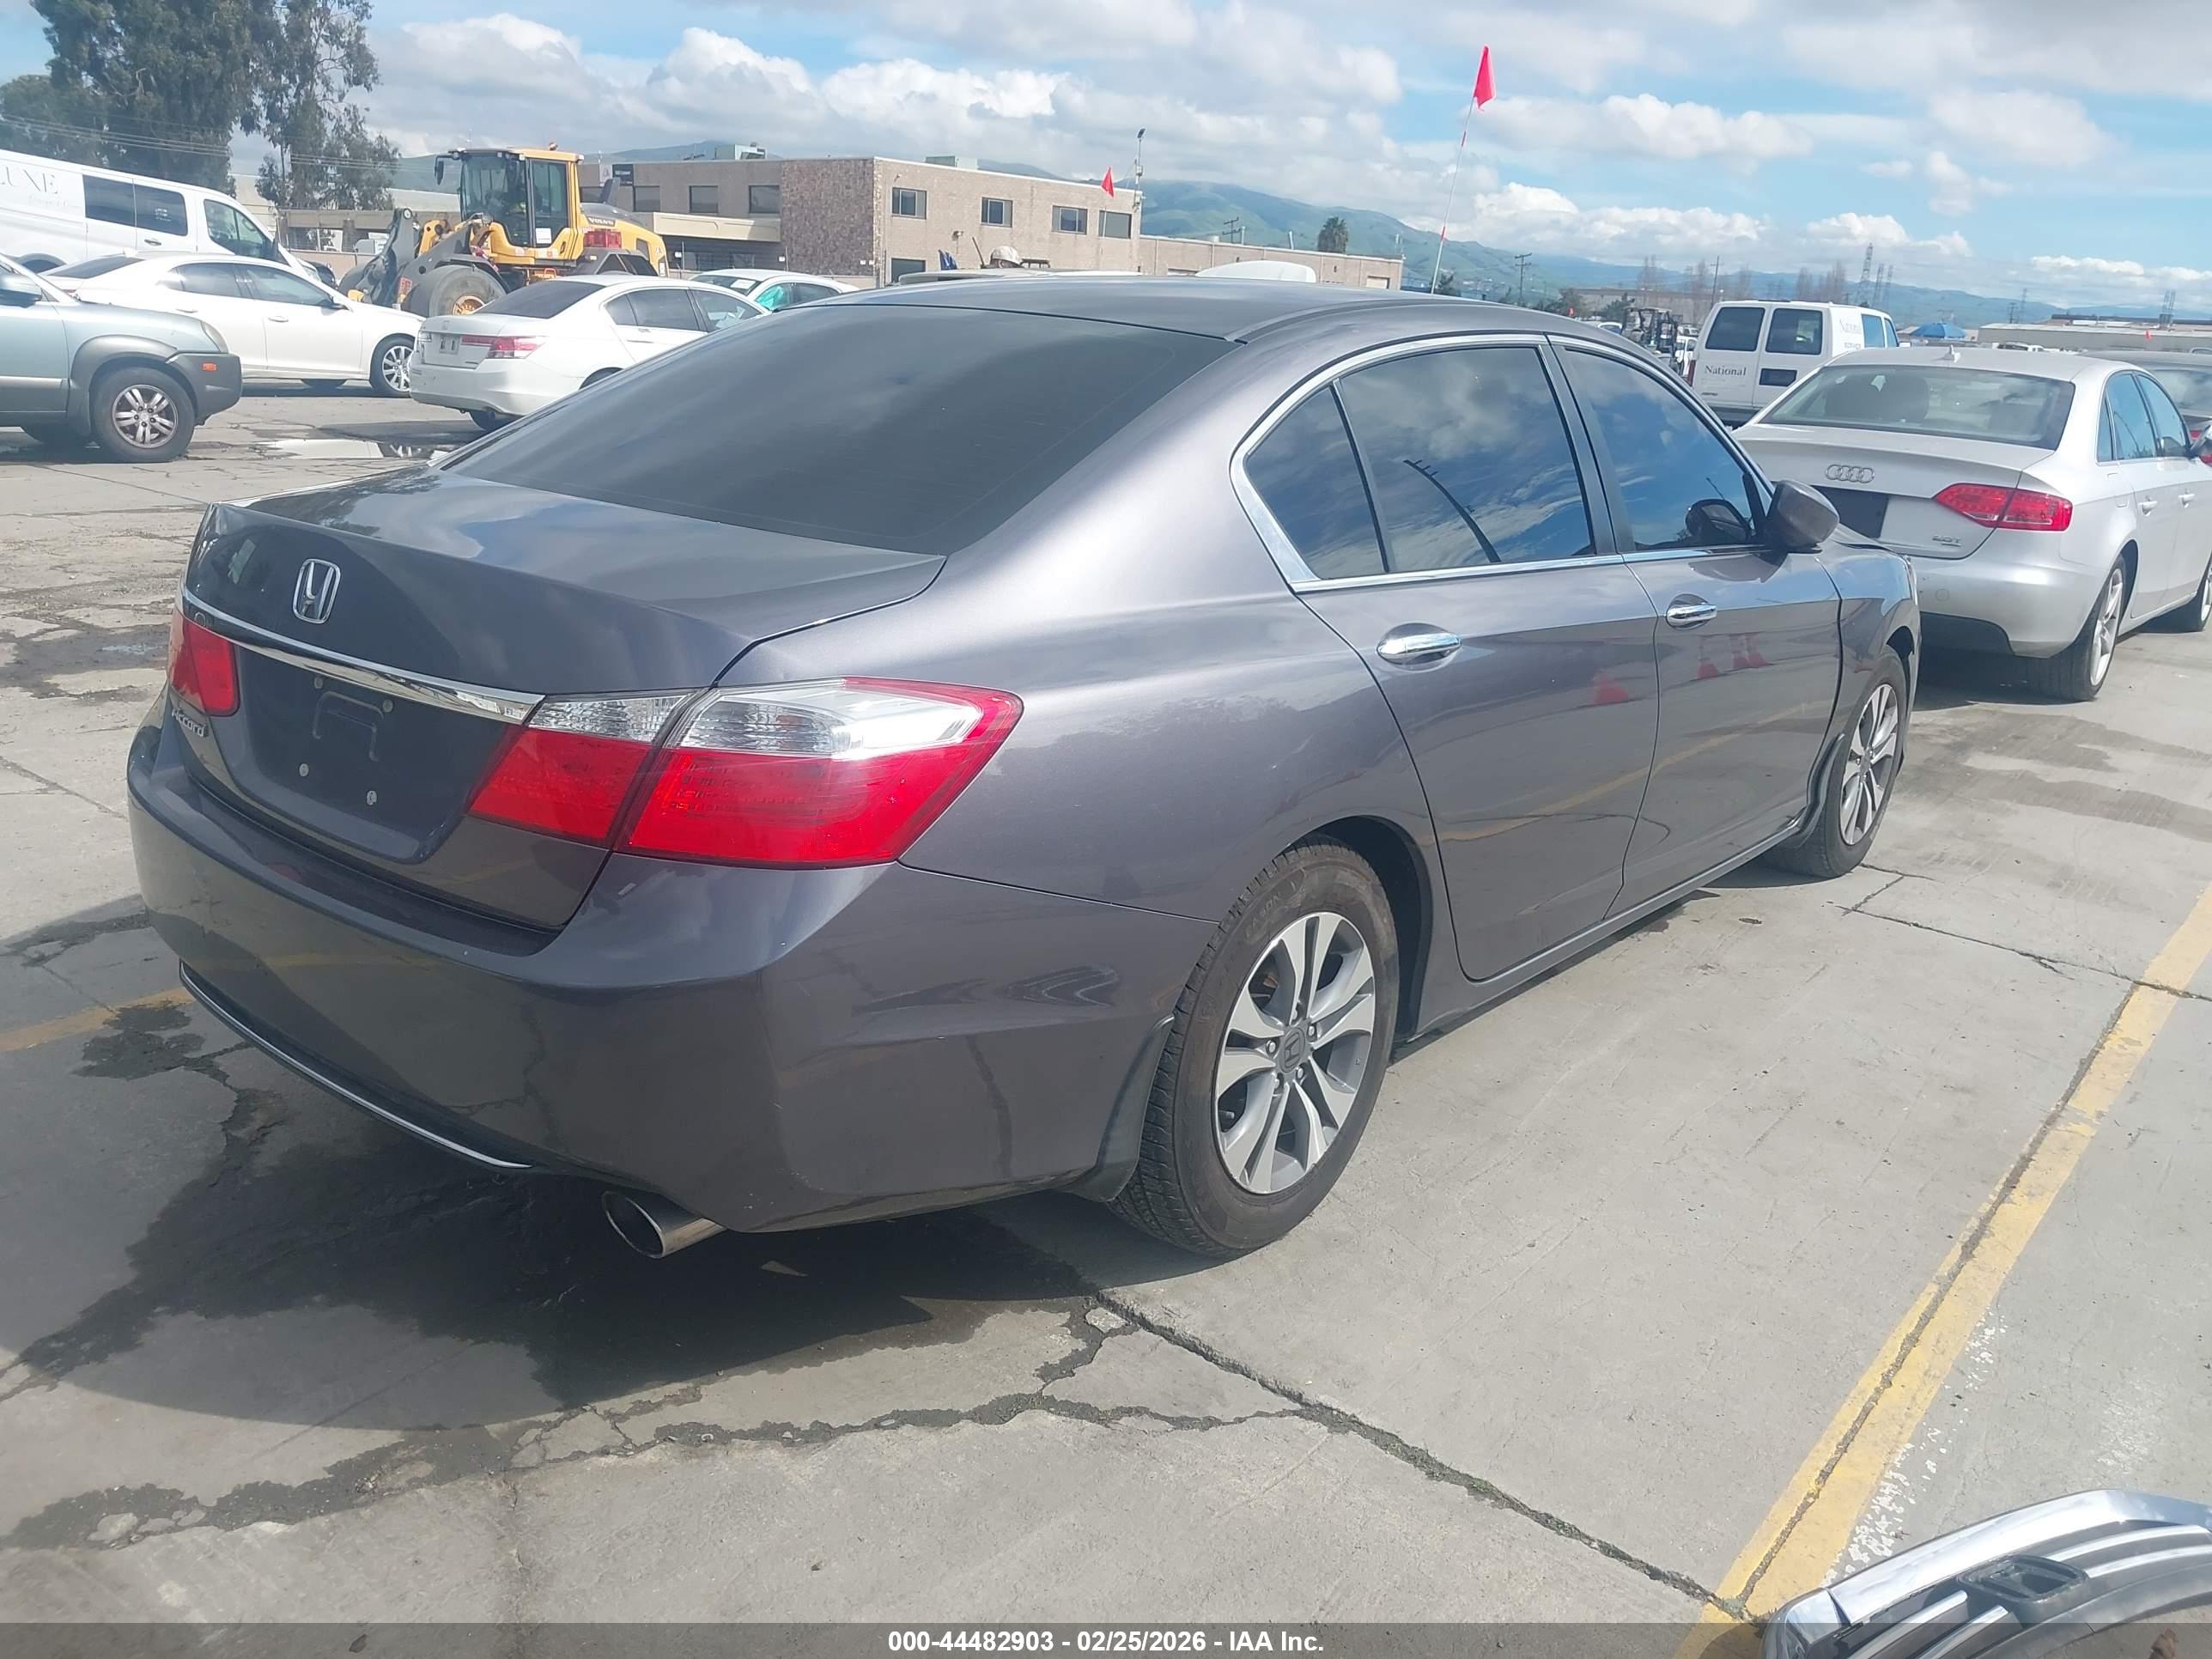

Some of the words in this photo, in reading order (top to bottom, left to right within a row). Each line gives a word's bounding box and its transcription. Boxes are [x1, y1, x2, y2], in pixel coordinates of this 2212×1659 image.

[587, 216, 614, 226] VOLVO
[1705, 365, 1747, 376] National
[171, 707, 207, 738] Accord
